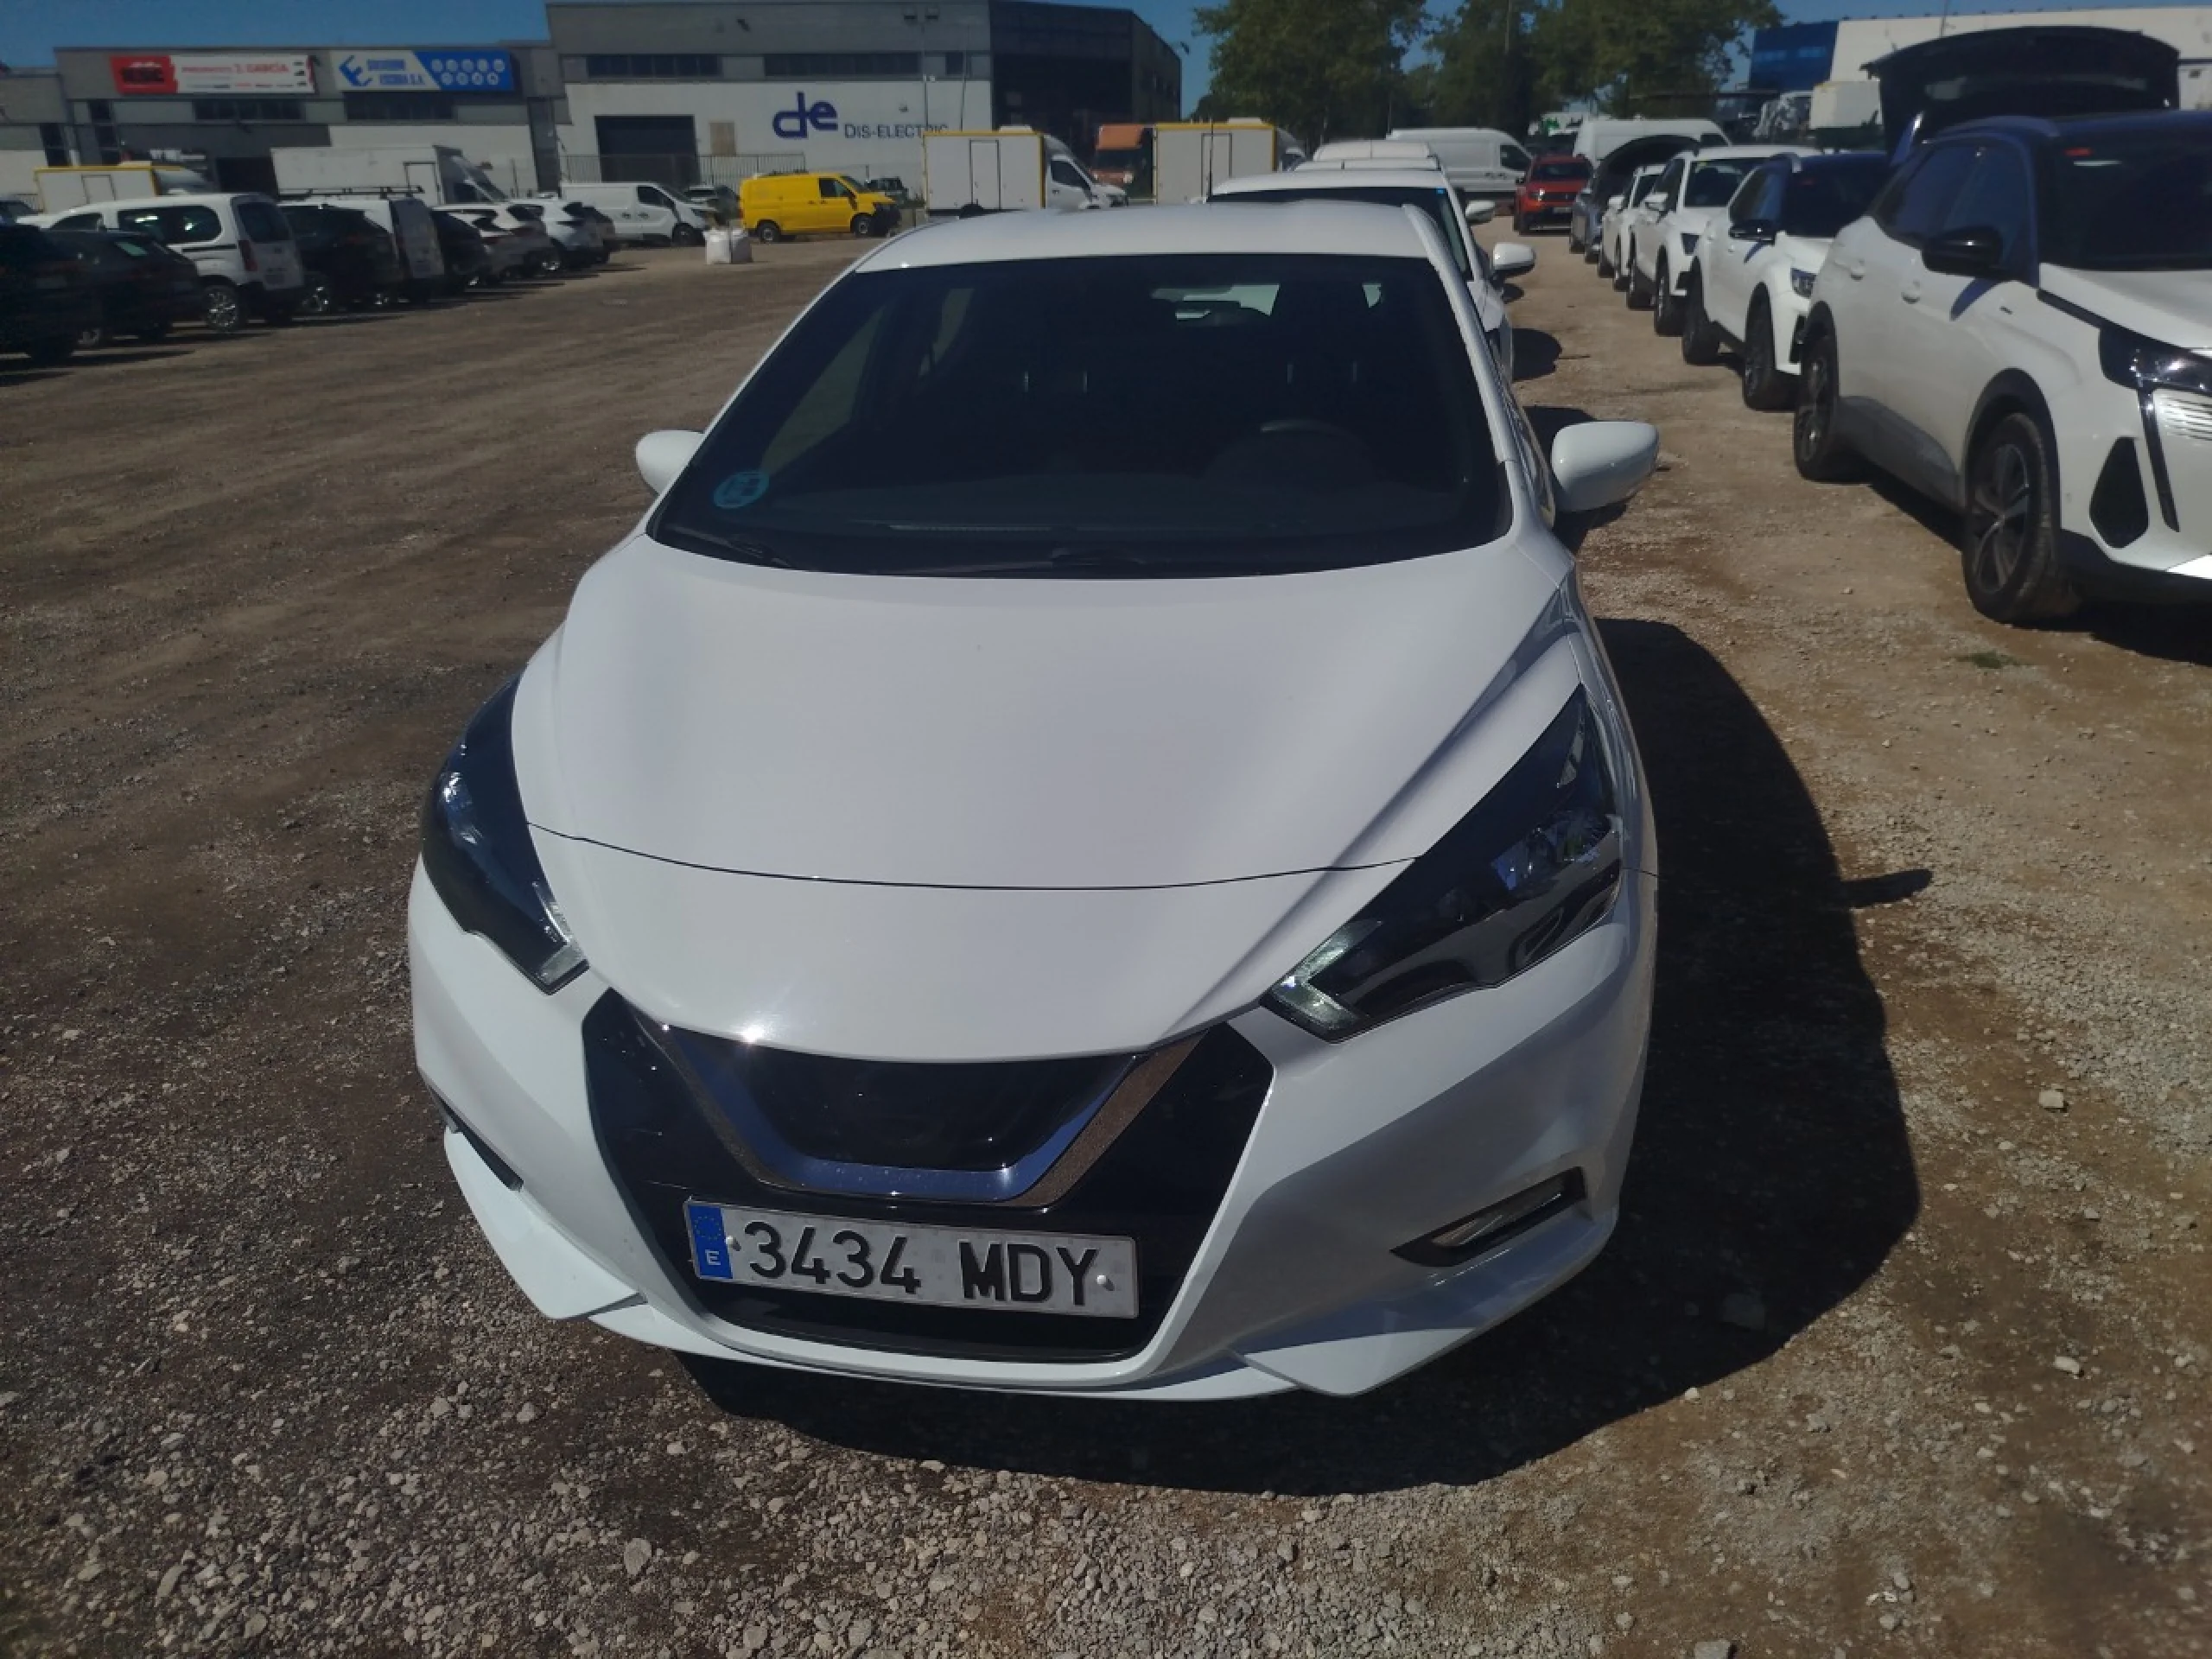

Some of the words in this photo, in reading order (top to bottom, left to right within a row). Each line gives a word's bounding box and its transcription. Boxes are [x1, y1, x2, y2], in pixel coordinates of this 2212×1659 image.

[704, 1249, 721, 1266] E
[743, 1221, 922, 1296] 3434
[957, 1239, 1099, 1307] MDY
